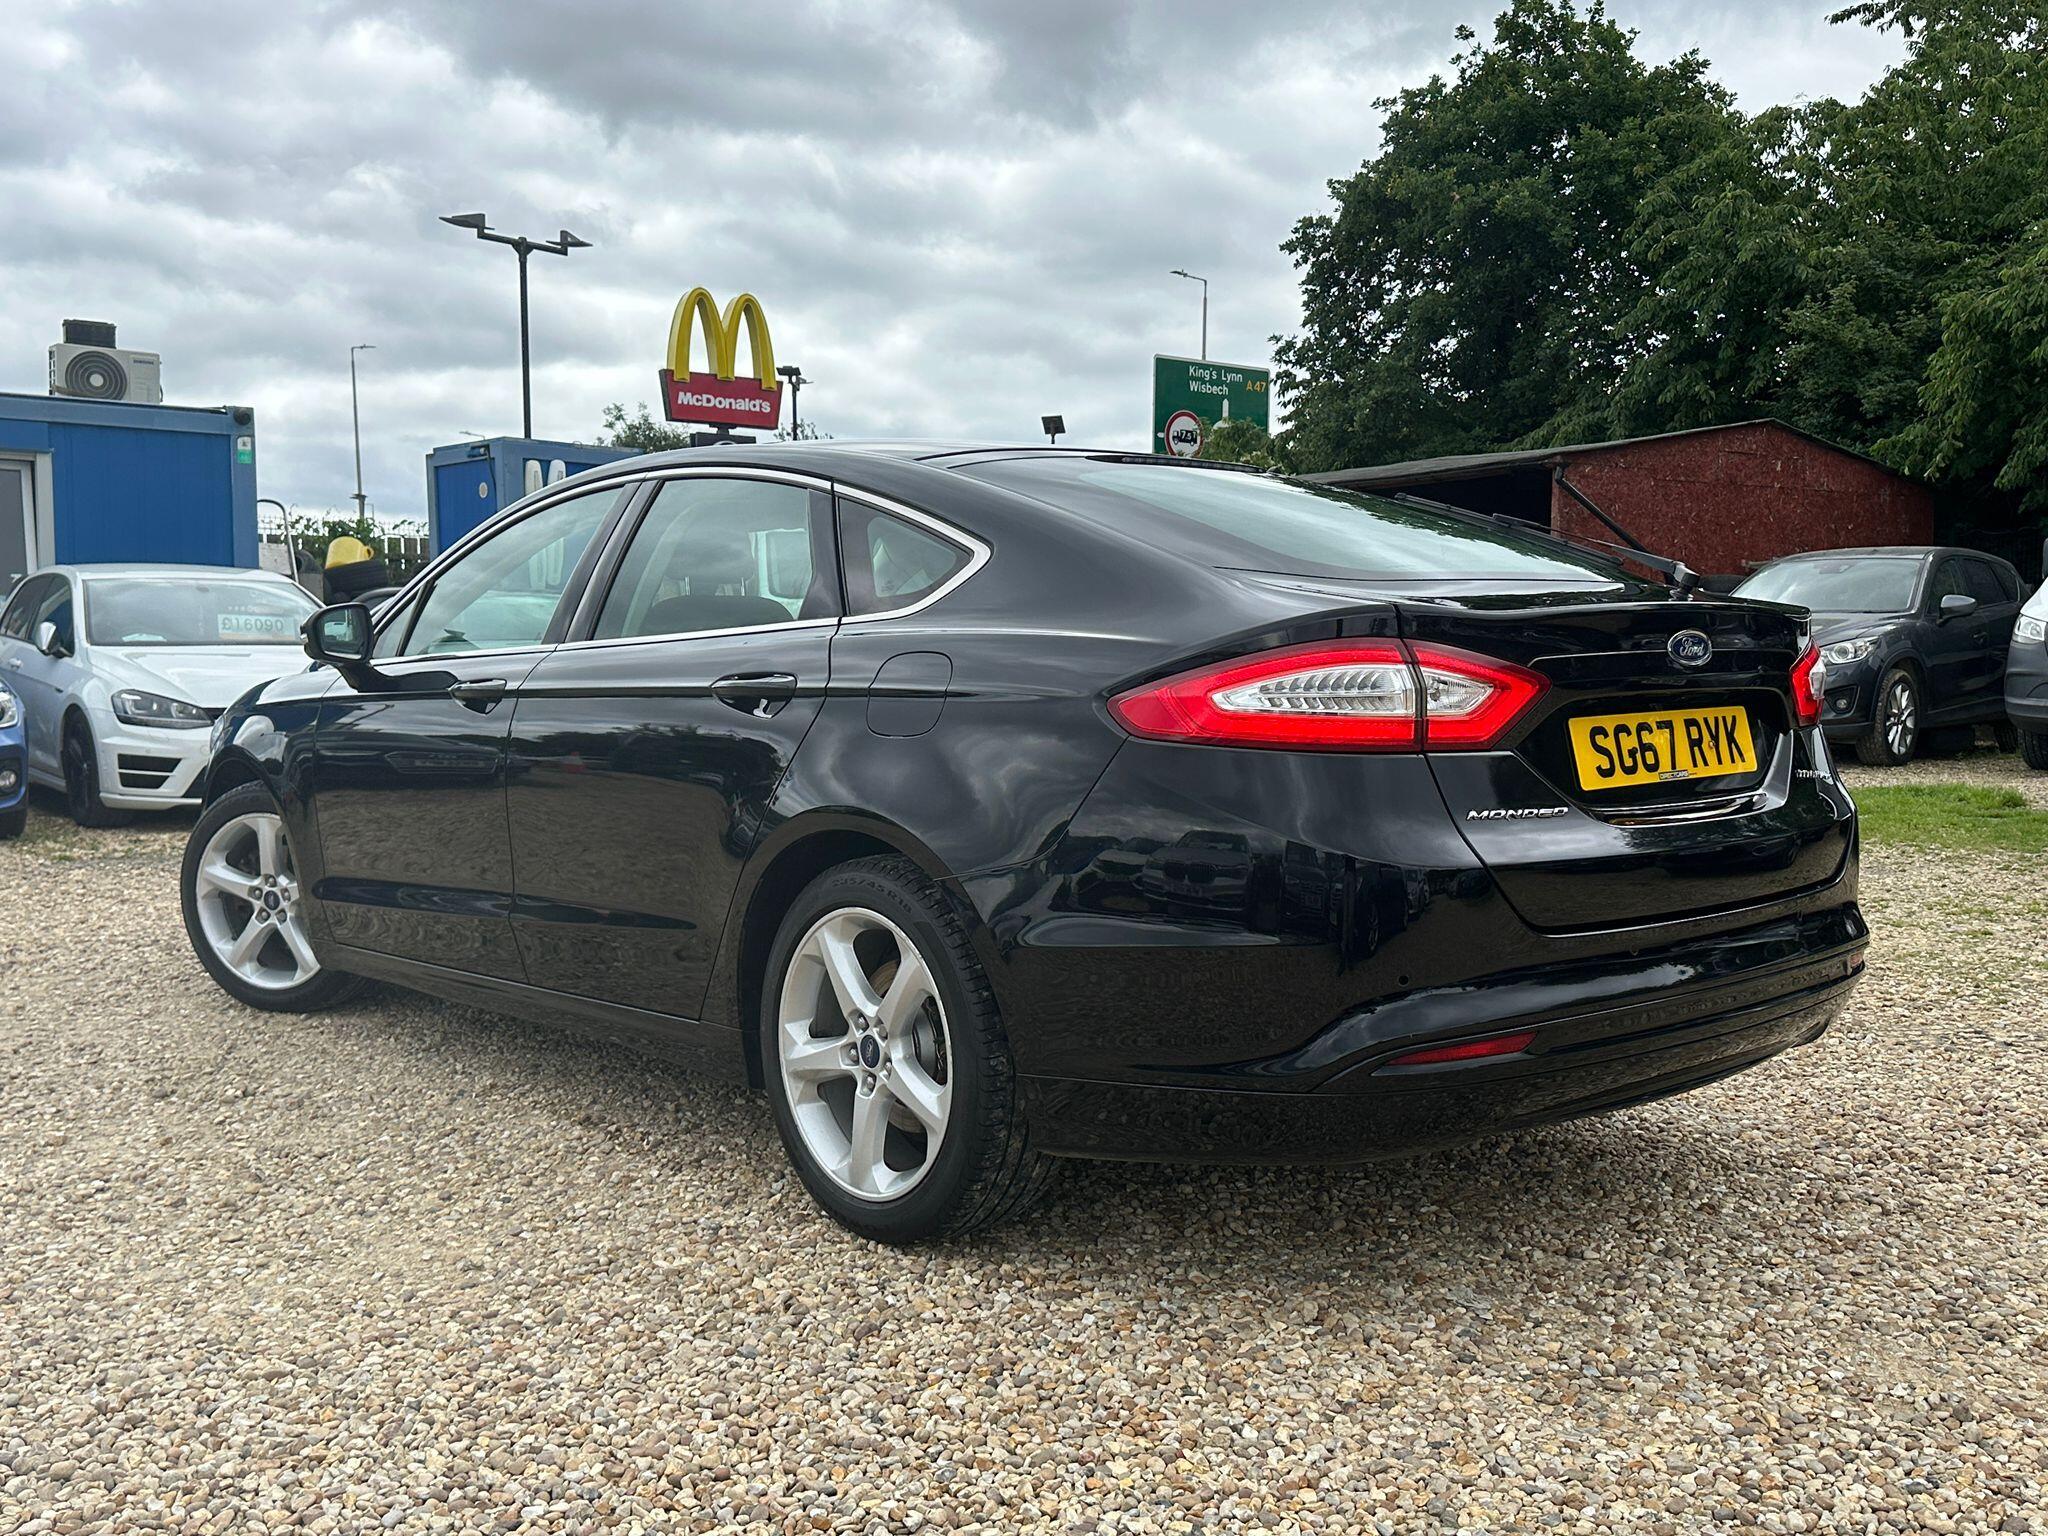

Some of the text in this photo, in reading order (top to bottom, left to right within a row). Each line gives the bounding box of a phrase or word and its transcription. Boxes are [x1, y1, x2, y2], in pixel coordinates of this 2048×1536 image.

[1189, 365, 1243, 383] King's Lynn
[1189, 380, 1229, 395] Wisbech
[1246, 380, 1267, 393] A47
[677, 391, 771, 413] McDonald's
[222, 616, 284, 632] £16090
[1680, 637, 1705, 656] Ford
[1589, 715, 1746, 779] SG67 RYK
[1466, 807, 1569, 821] MONDEO
